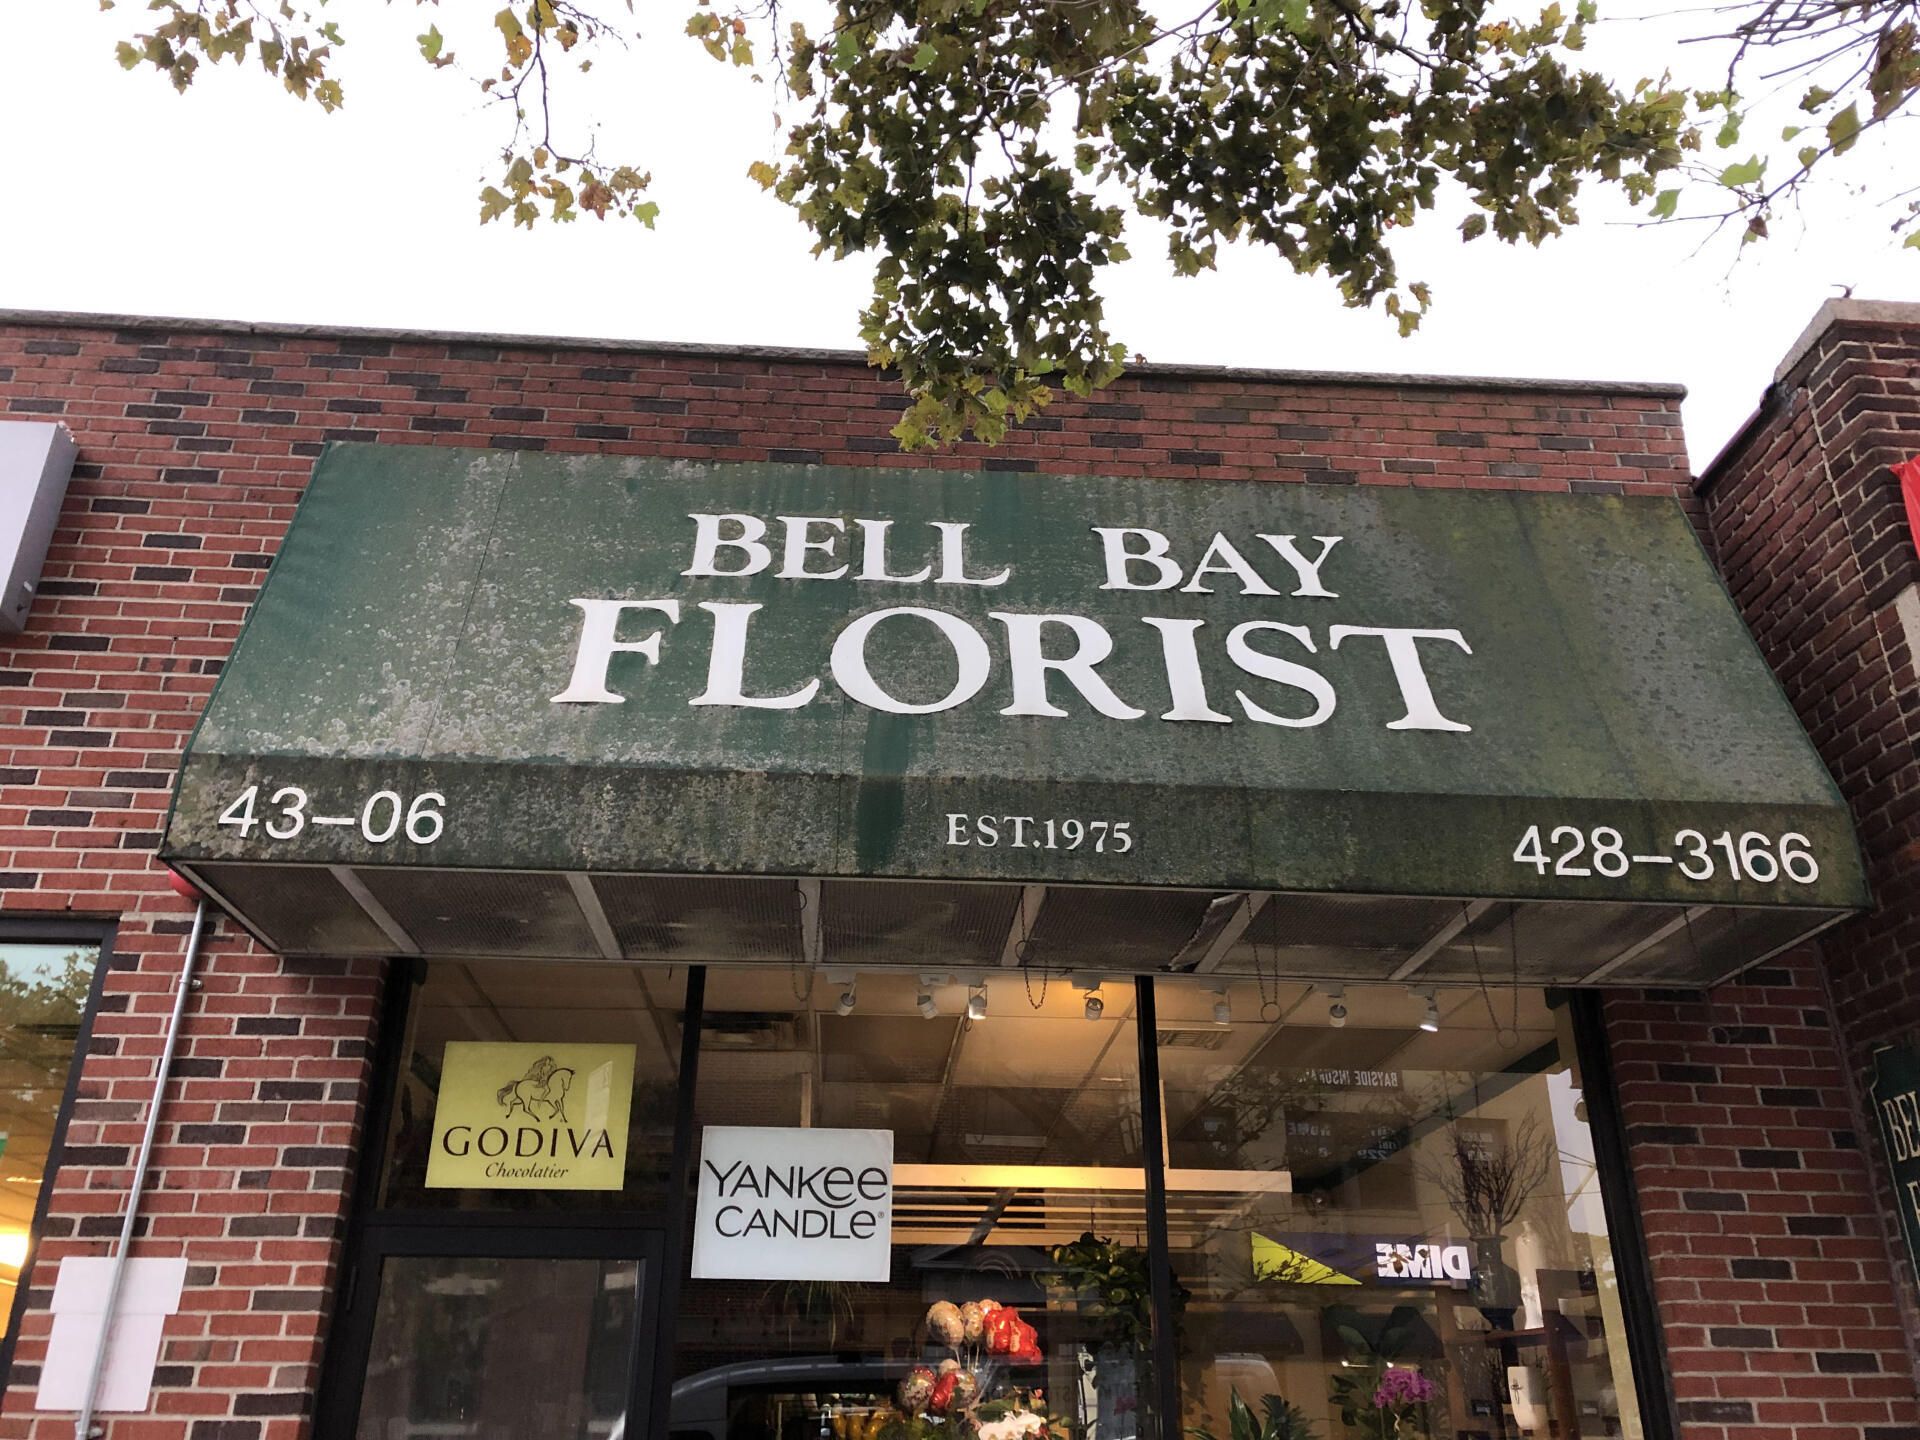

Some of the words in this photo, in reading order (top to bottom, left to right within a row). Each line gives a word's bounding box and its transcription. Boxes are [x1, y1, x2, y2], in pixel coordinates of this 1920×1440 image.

[680, 513, 1011, 586] BELL
[1091, 527, 1343, 598] BAY
[549, 598, 1473, 732] FLORIST
[218, 785, 446, 844] 43-06
[946, 813, 1132, 853] EST.1975
[1513, 824, 1819, 884] 428-3166
[442, 1126, 614, 1158] GODIVA
[485, 1162, 569, 1178] Chocolatier
[704, 1160, 888, 1209] YANKee
